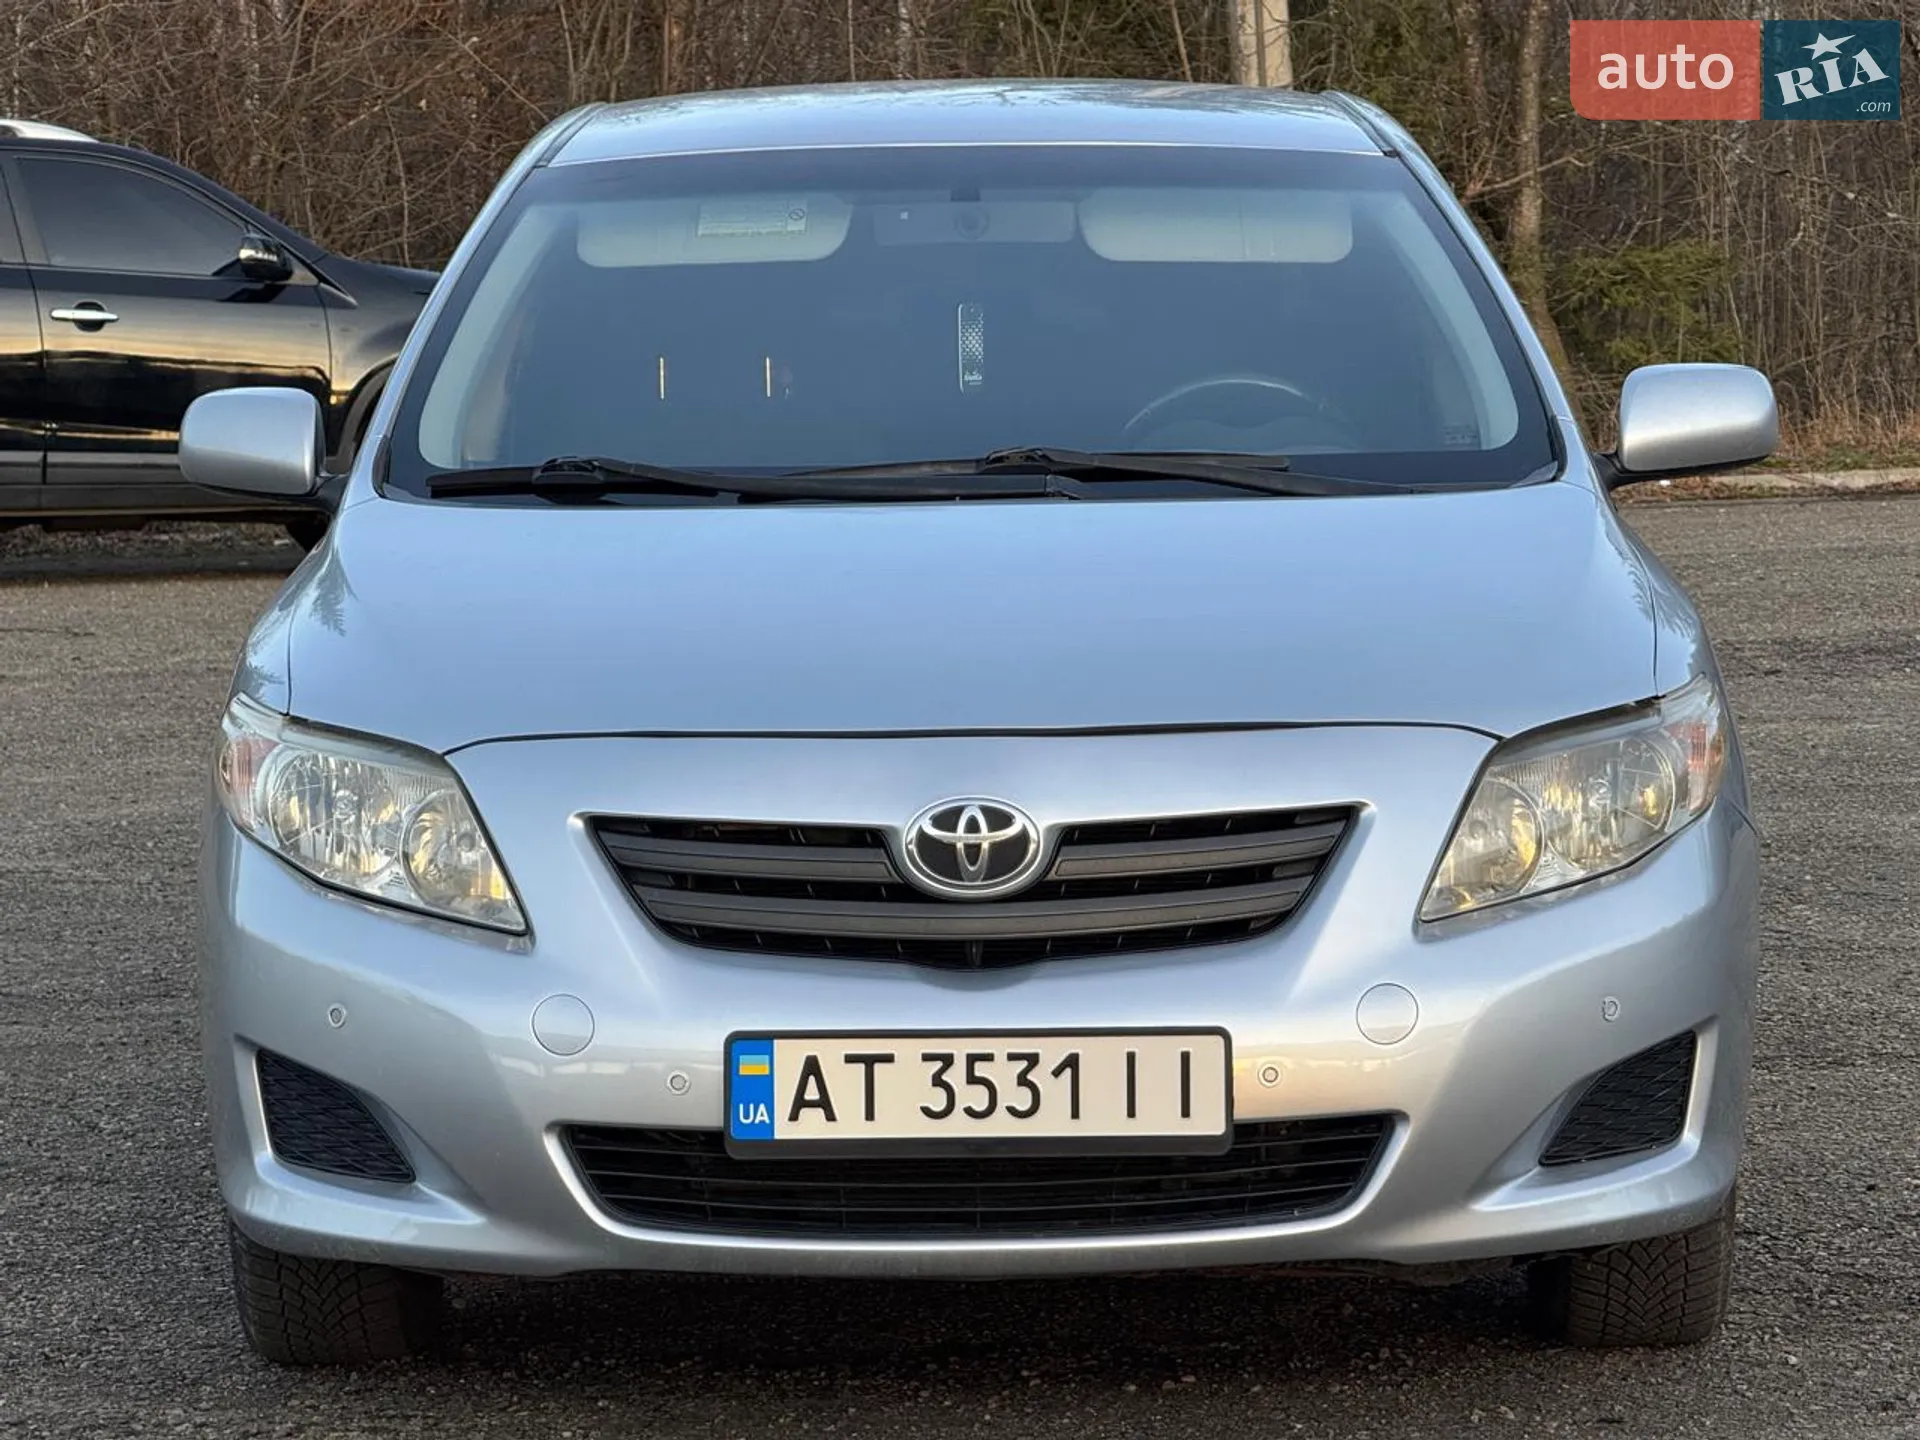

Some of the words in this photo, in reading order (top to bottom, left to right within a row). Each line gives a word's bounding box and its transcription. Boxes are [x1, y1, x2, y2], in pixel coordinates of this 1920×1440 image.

[788, 1054, 896, 1122] AT
[920, 1051, 1080, 1120] 3531
[739, 1104, 770, 1125] UA
